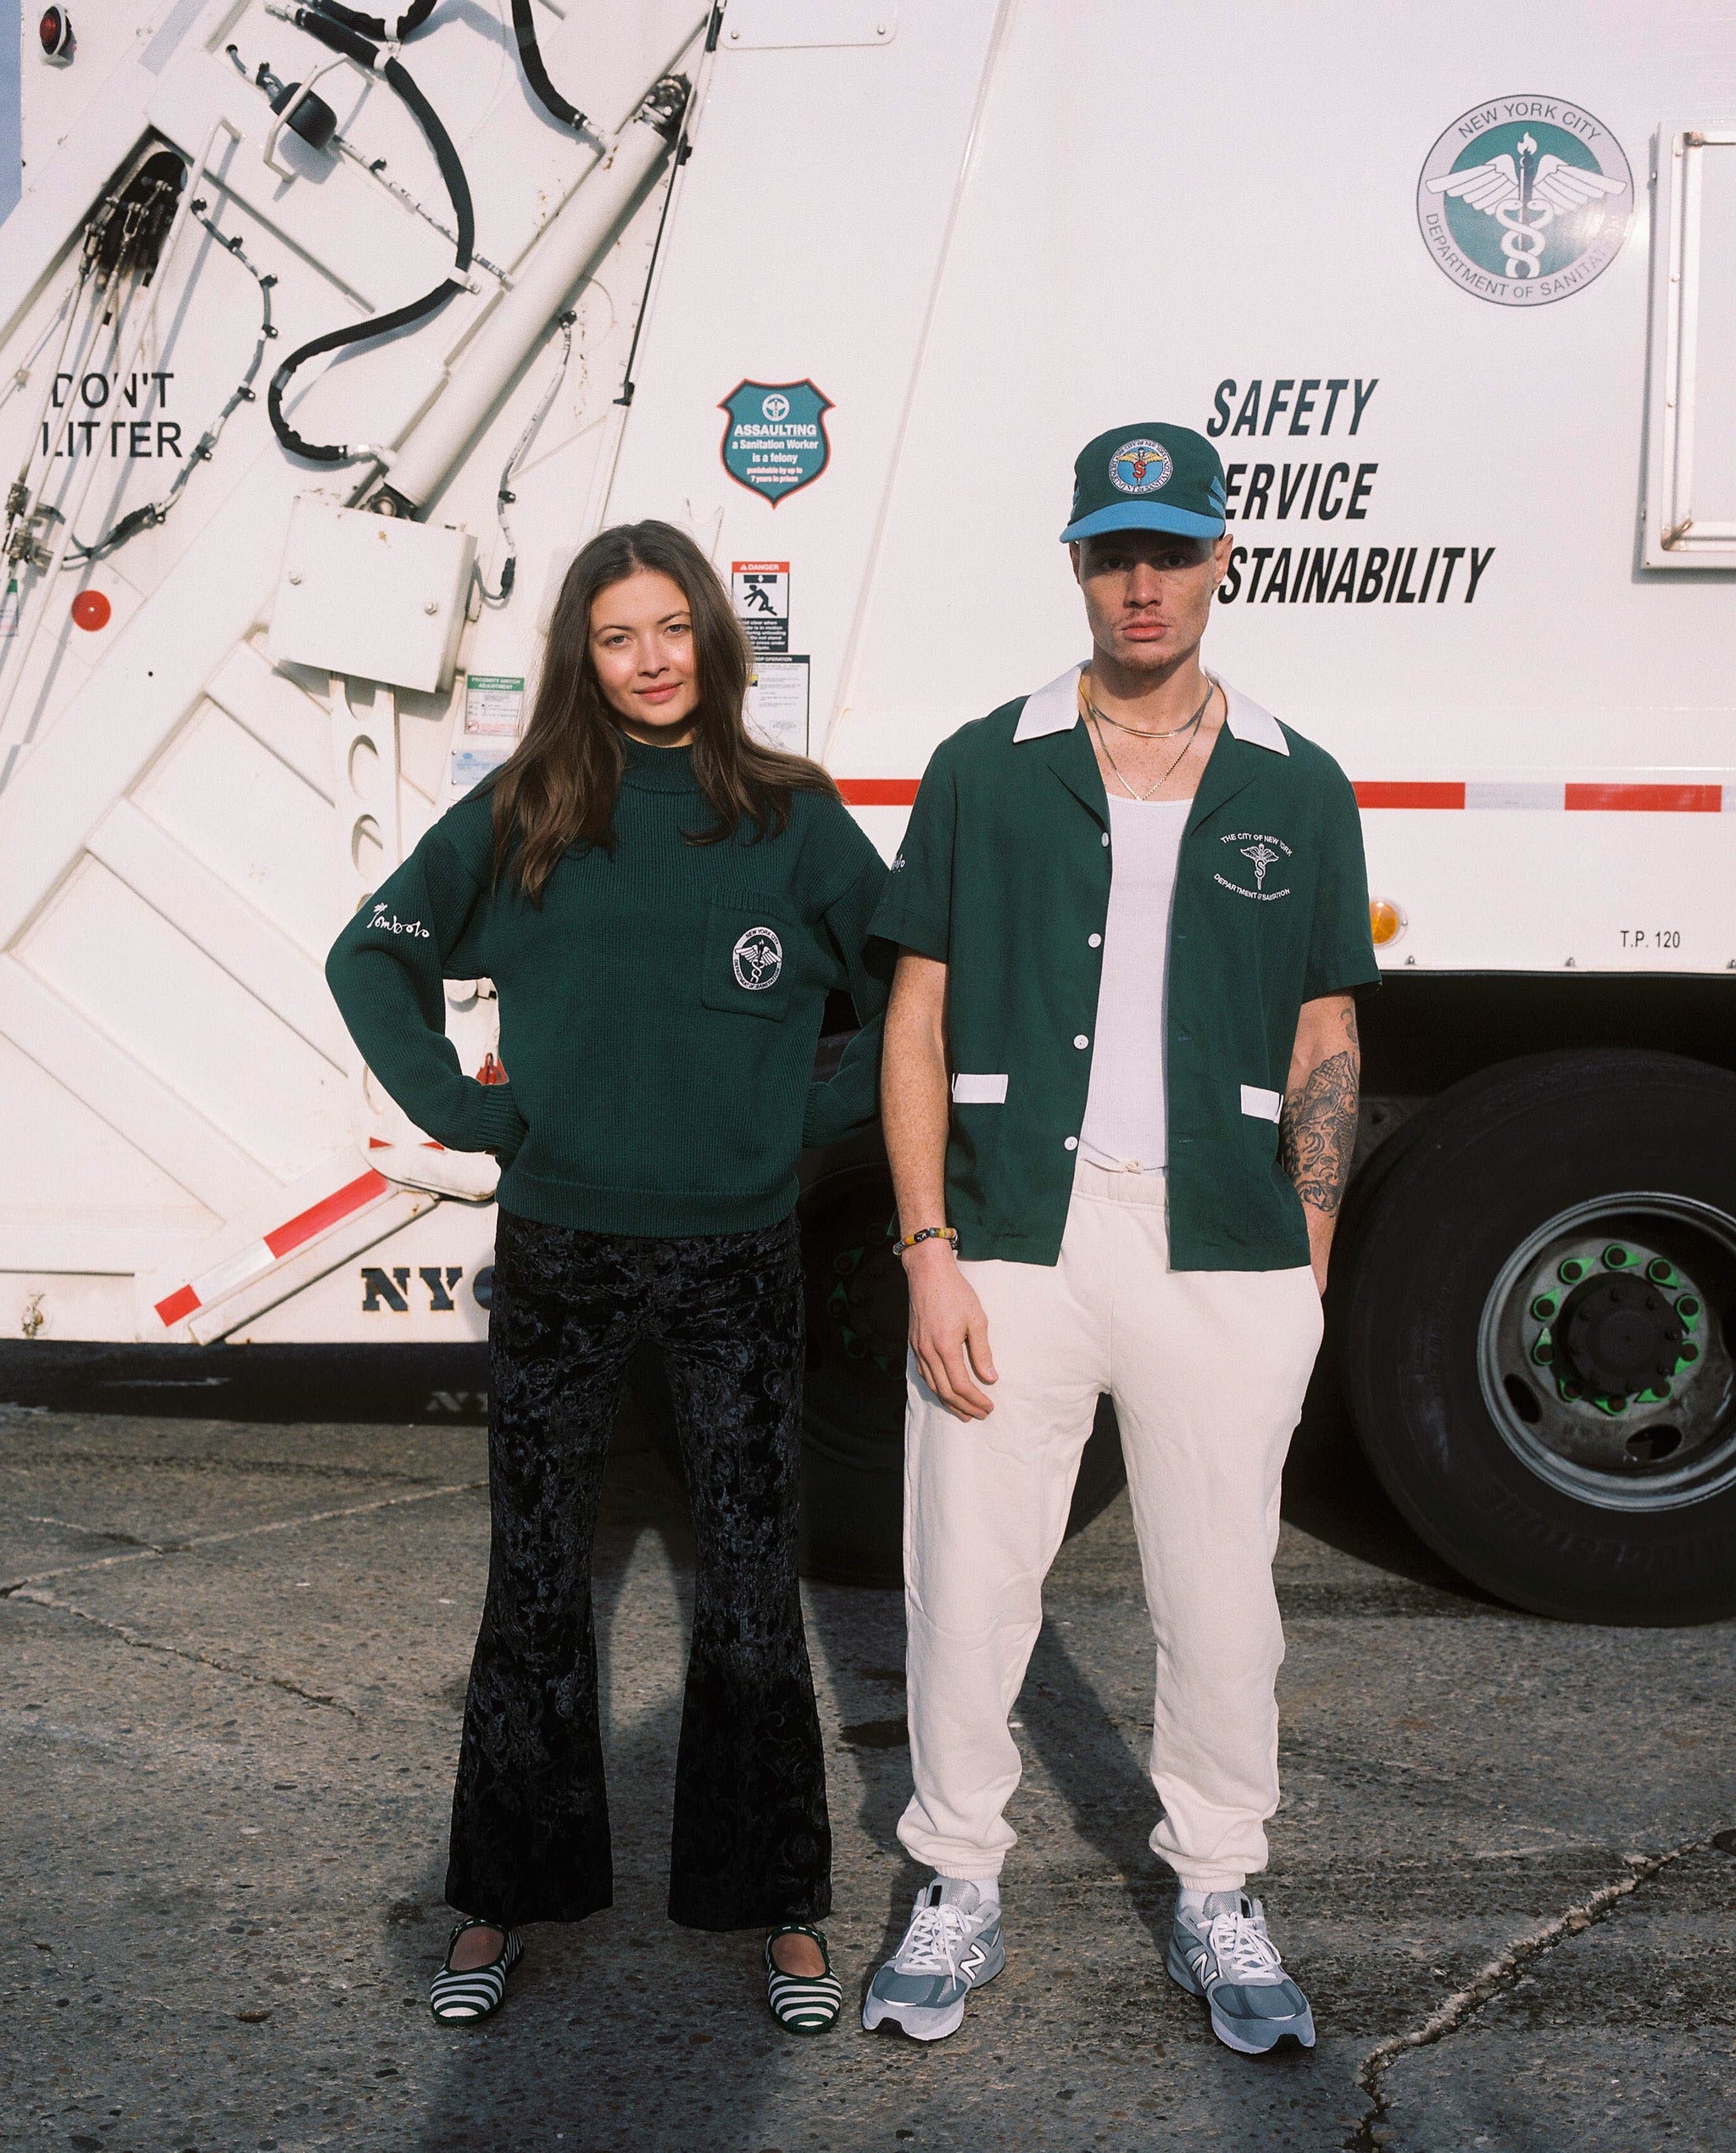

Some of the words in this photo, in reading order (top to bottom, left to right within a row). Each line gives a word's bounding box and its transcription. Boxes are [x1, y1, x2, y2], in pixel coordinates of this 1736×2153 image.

[1458, 108, 1498, 138] NEW
[1504, 102, 1558, 120] YORK
[1561, 111, 1601, 141] CITY
[1426, 213, 1510, 297] DEPARTMENT
[1513, 286, 1535, 298] OF
[1206, 378, 1379, 437] SAFETY
[42, 421, 182, 457] LITTER
[733, 424, 817, 437] ASSAULTING
[739, 439, 785, 449] Sanitation
[787, 439, 819, 449] Worker
[752, 453, 762, 463] is
[762, 454, 768, 463] a
[770, 453, 798, 465] felony
[1224, 462, 1379, 520] ERVICE
[1214, 546, 1496, 604] STAINABILITY
[1221, 833, 1237, 843] THE
[1264, 835, 1279, 844] NEW
[1213, 873, 1257, 899] DEPARTMENT
[366, 902, 430, 938] Tombolo
[745, 929, 757, 938] NEW
[757, 928, 771, 937] YORK
[771, 934, 779, 945] CITY
[1620, 930, 1649, 948] T.P.
[1655, 931, 1681, 949] 120
[733, 959, 749, 988] DEPARTMENT
[755, 968, 781, 989] SANITATION
